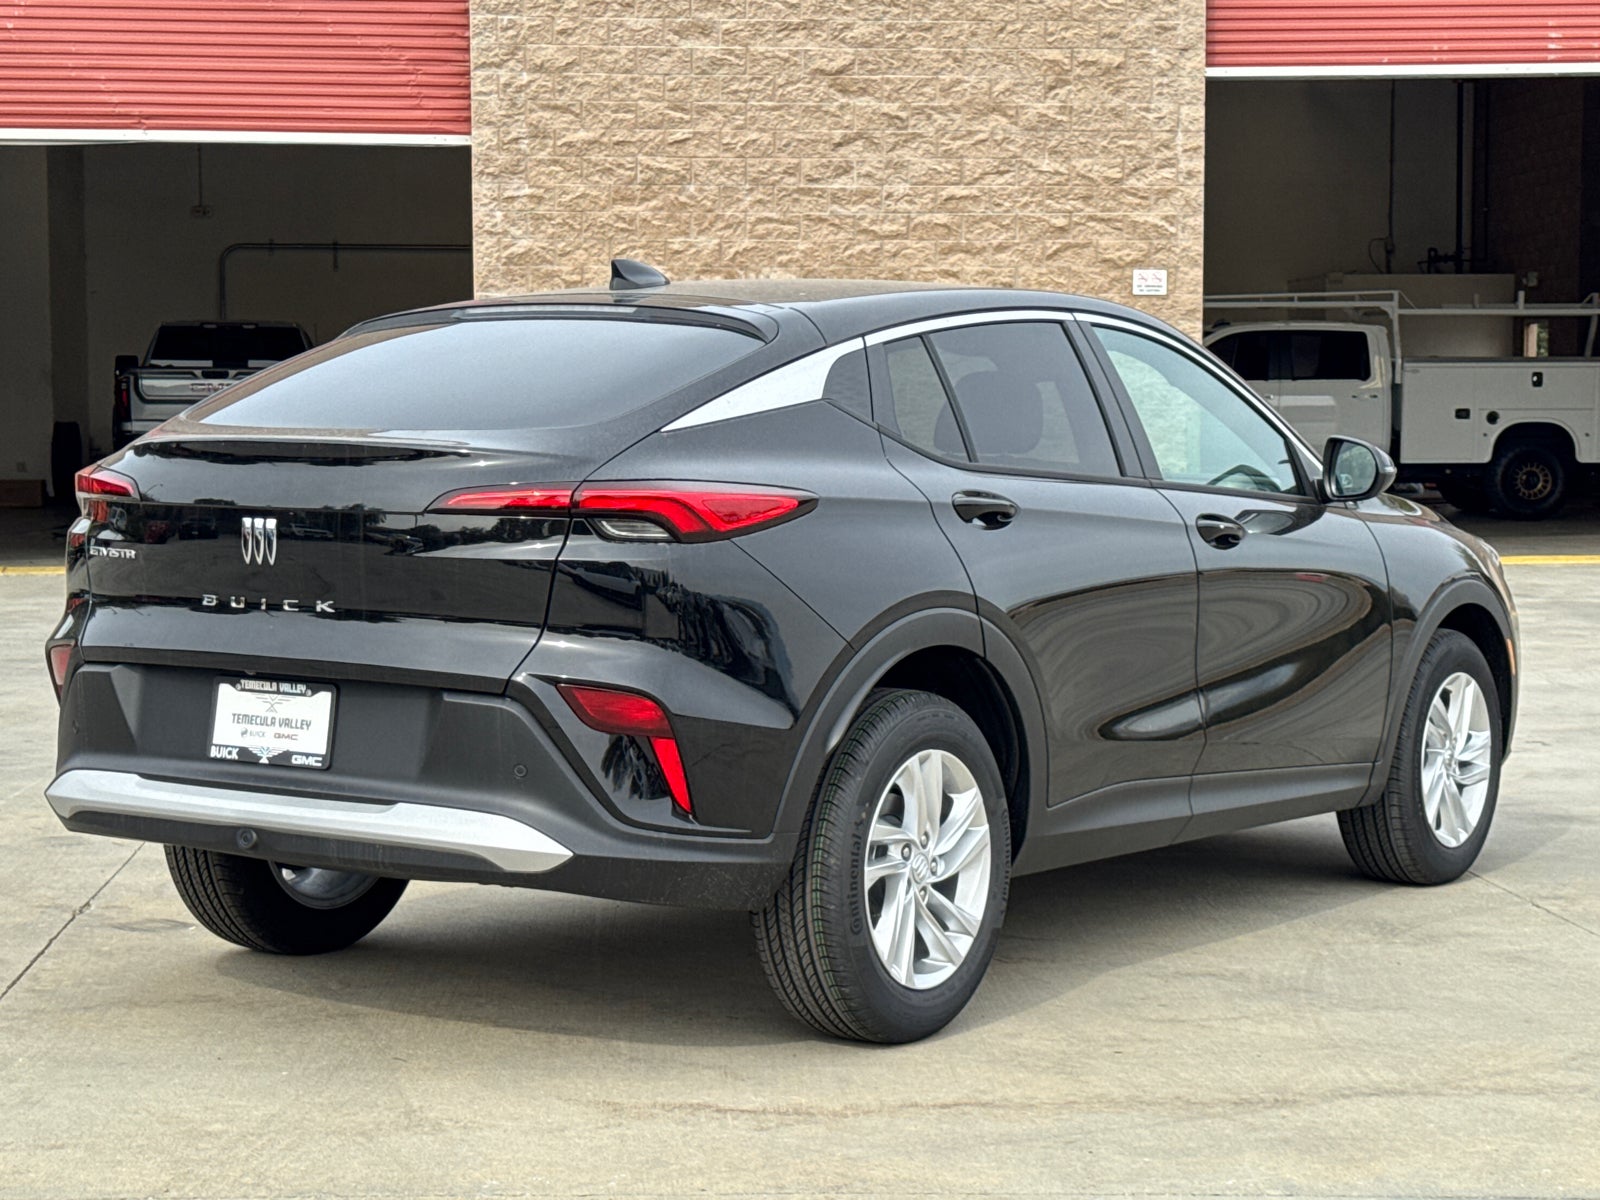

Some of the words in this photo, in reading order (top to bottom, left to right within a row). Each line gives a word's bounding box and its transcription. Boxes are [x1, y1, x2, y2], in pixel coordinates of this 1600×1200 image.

[202, 594, 335, 612] BUICK
[241, 679, 277, 692] TEMECULA
[279, 682, 306, 694] VALLEY
[232, 713, 276, 727] TEMECULA
[278, 718, 312, 731] VALLEY
[274, 732, 298, 741] GMC
[210, 745, 240, 760] BUICK
[291, 754, 322, 767] GMC
